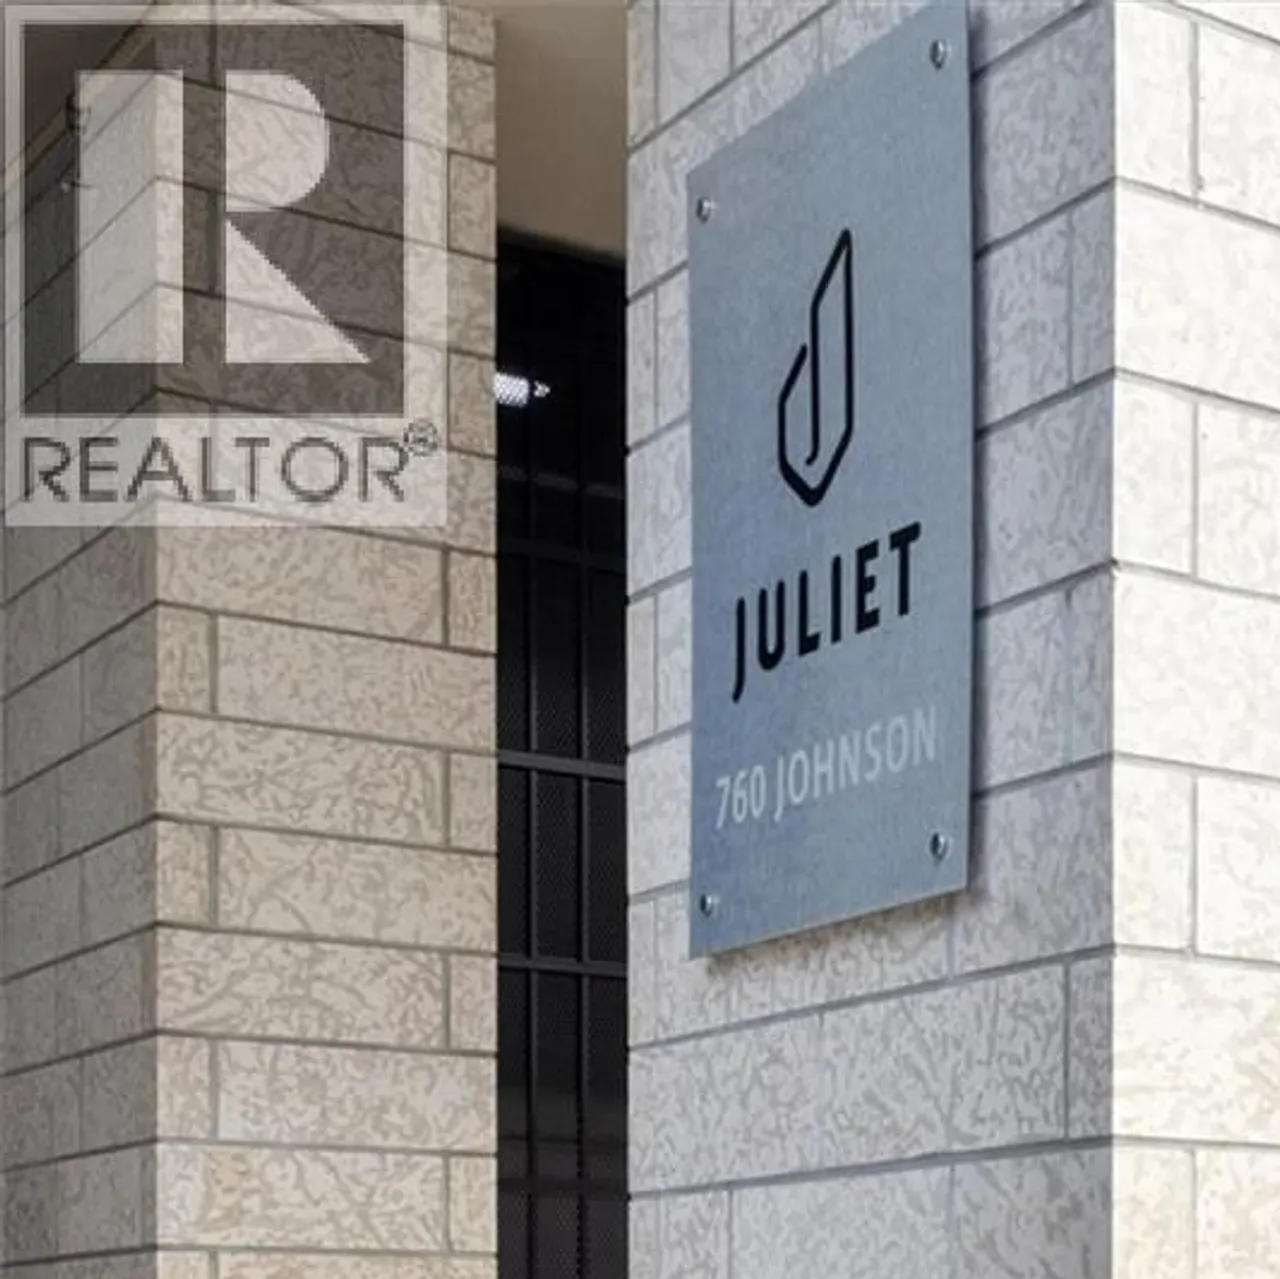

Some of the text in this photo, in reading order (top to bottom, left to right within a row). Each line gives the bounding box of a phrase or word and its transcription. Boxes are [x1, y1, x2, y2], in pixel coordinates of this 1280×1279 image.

[732, 521, 921, 703] JULIET
[715, 705, 936, 829] 760 JOHNSON
